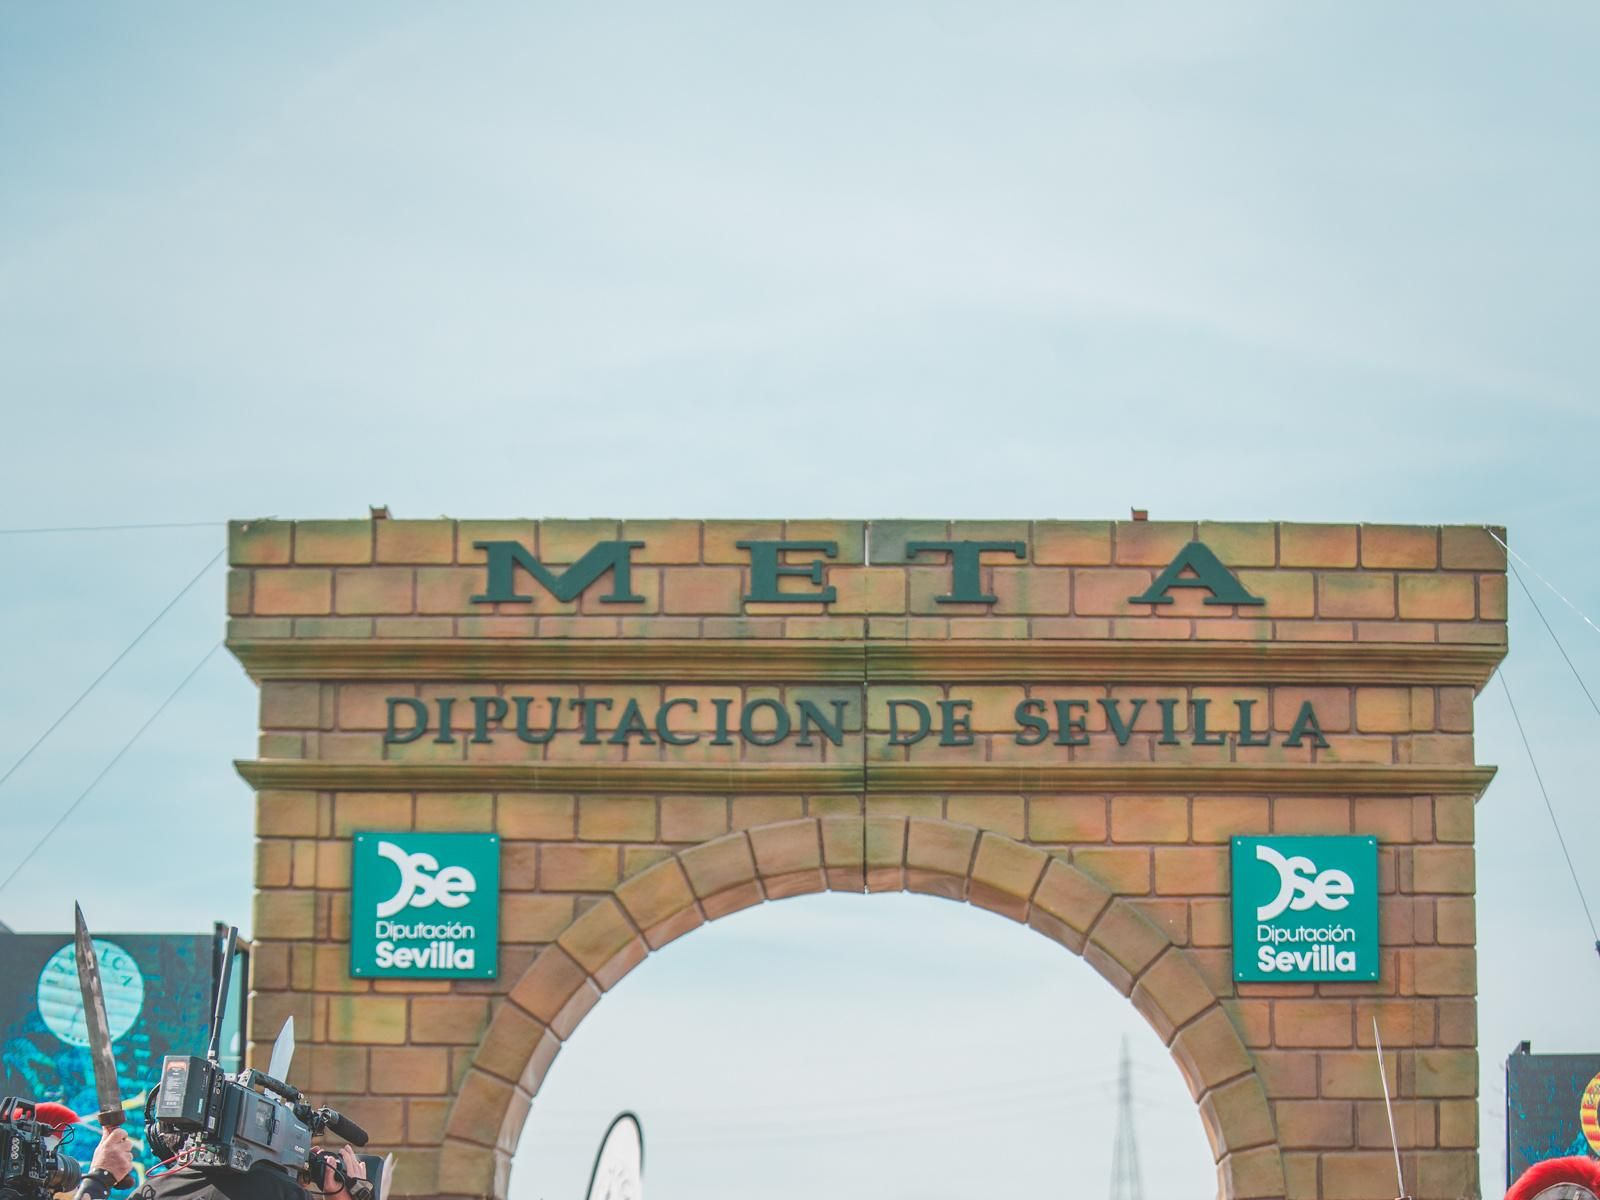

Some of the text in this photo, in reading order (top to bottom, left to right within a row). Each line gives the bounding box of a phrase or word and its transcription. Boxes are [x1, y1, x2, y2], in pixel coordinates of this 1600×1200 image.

[470, 540, 1265, 606] META
[384, 696, 1330, 748] DIPUTACION DE SEVILLA
[375, 920, 475, 942] Diputación
[1257, 923, 1356, 946] Diputación
[375, 941, 475, 970] Sevilla
[1257, 944, 1356, 973] Sevilla
